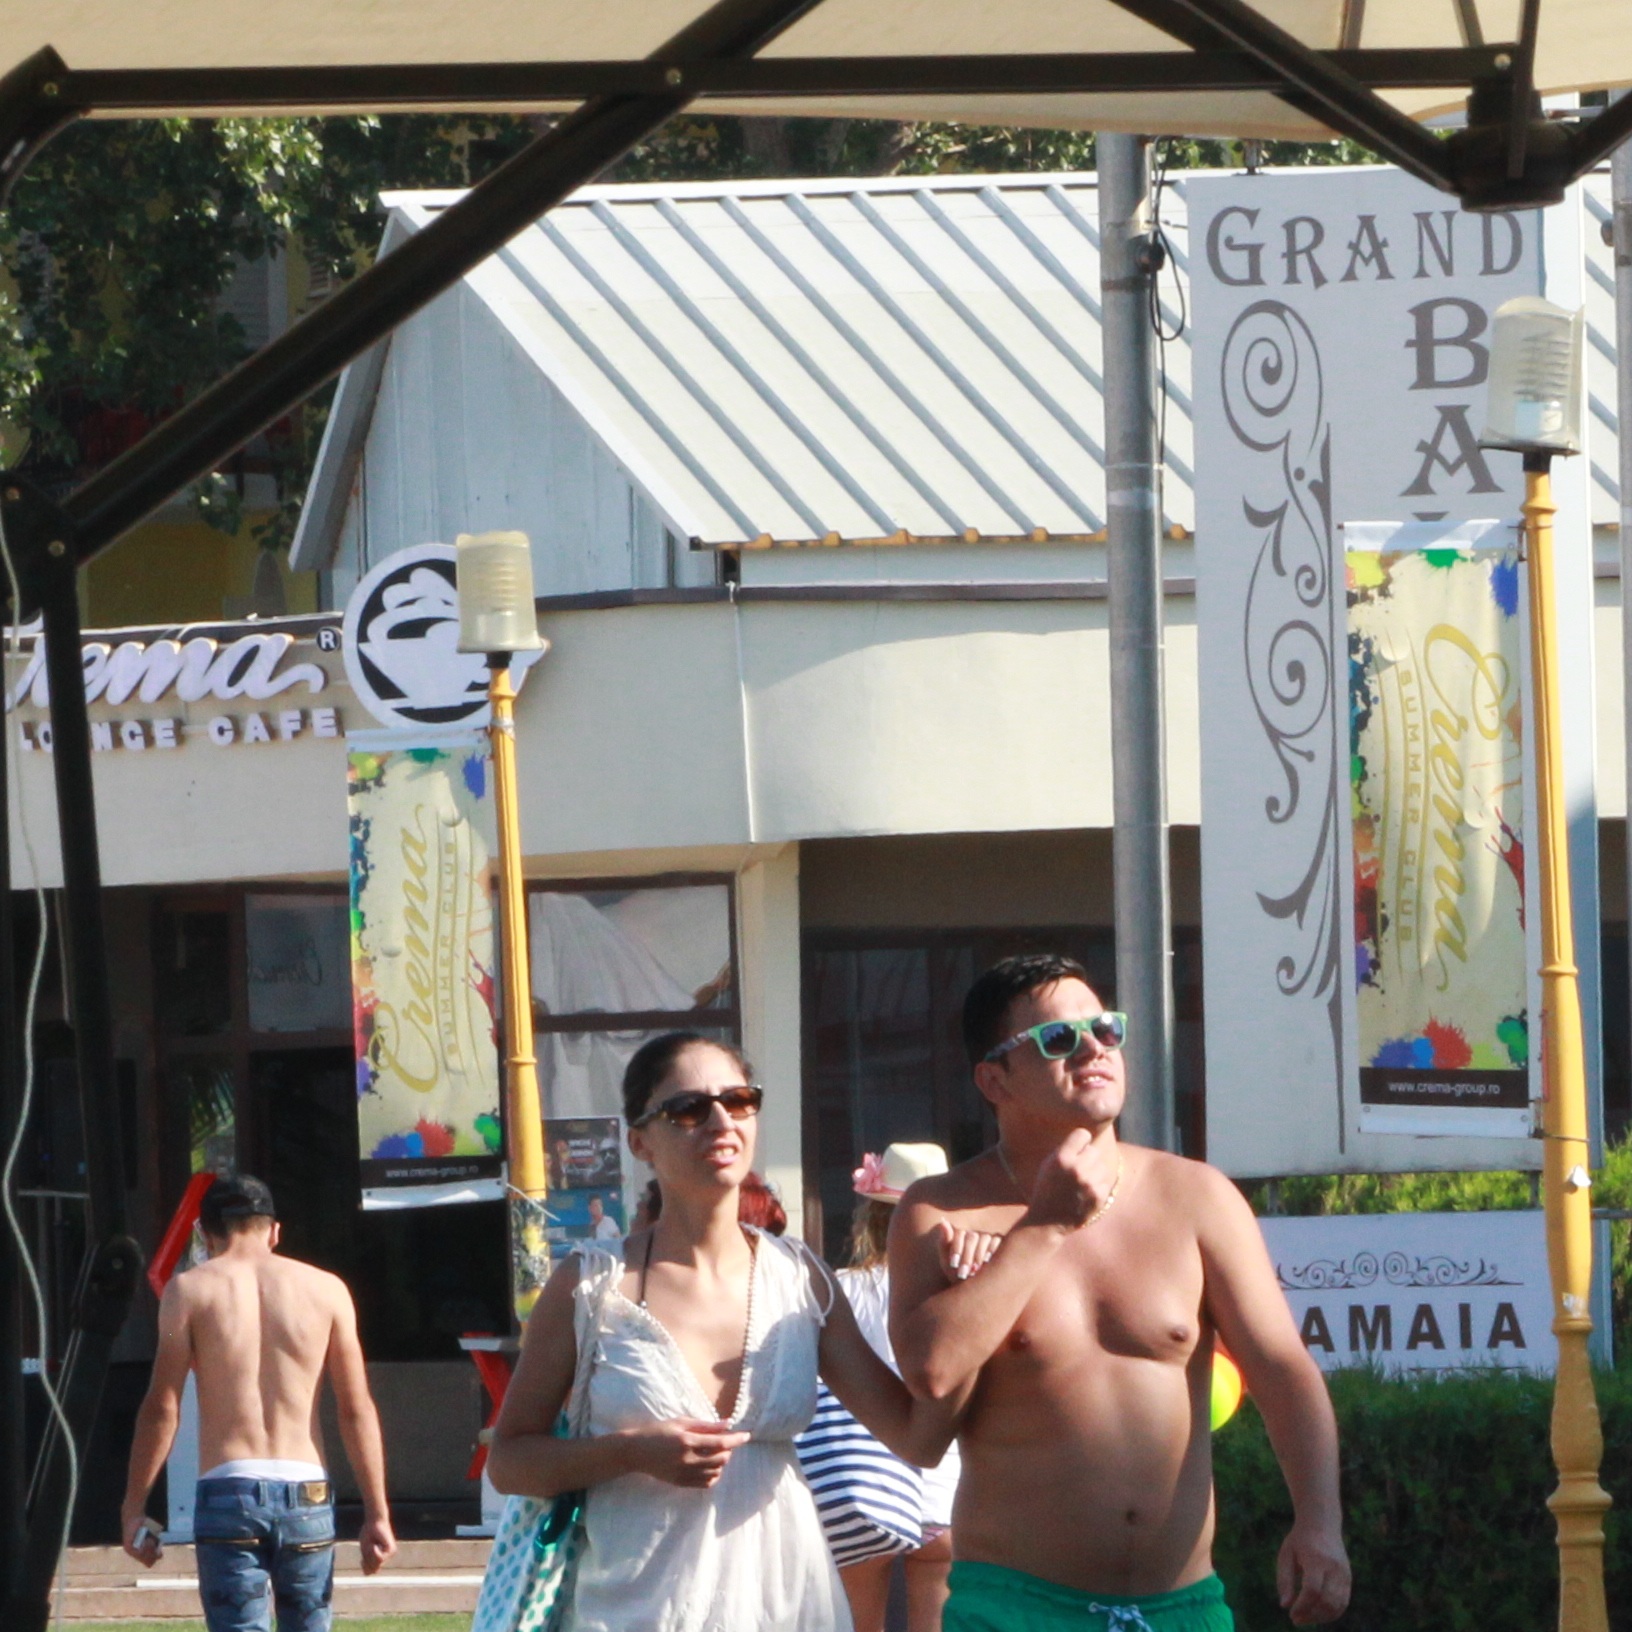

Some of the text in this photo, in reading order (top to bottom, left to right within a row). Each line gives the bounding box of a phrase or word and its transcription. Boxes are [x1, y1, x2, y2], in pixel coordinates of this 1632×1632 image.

[1206, 206, 1523, 289] GRAND
[1398, 297, 1505, 521] BA
[208, 708, 336, 746] CAFE
[1424, 624, 1510, 991] Crema
[442, 842, 459, 913] CLUB
[1400, 849, 1418, 942] CLUB
[369, 803, 439, 1092] Crema
[1388, 1081, 1501, 1096] www.crema-group.ro
